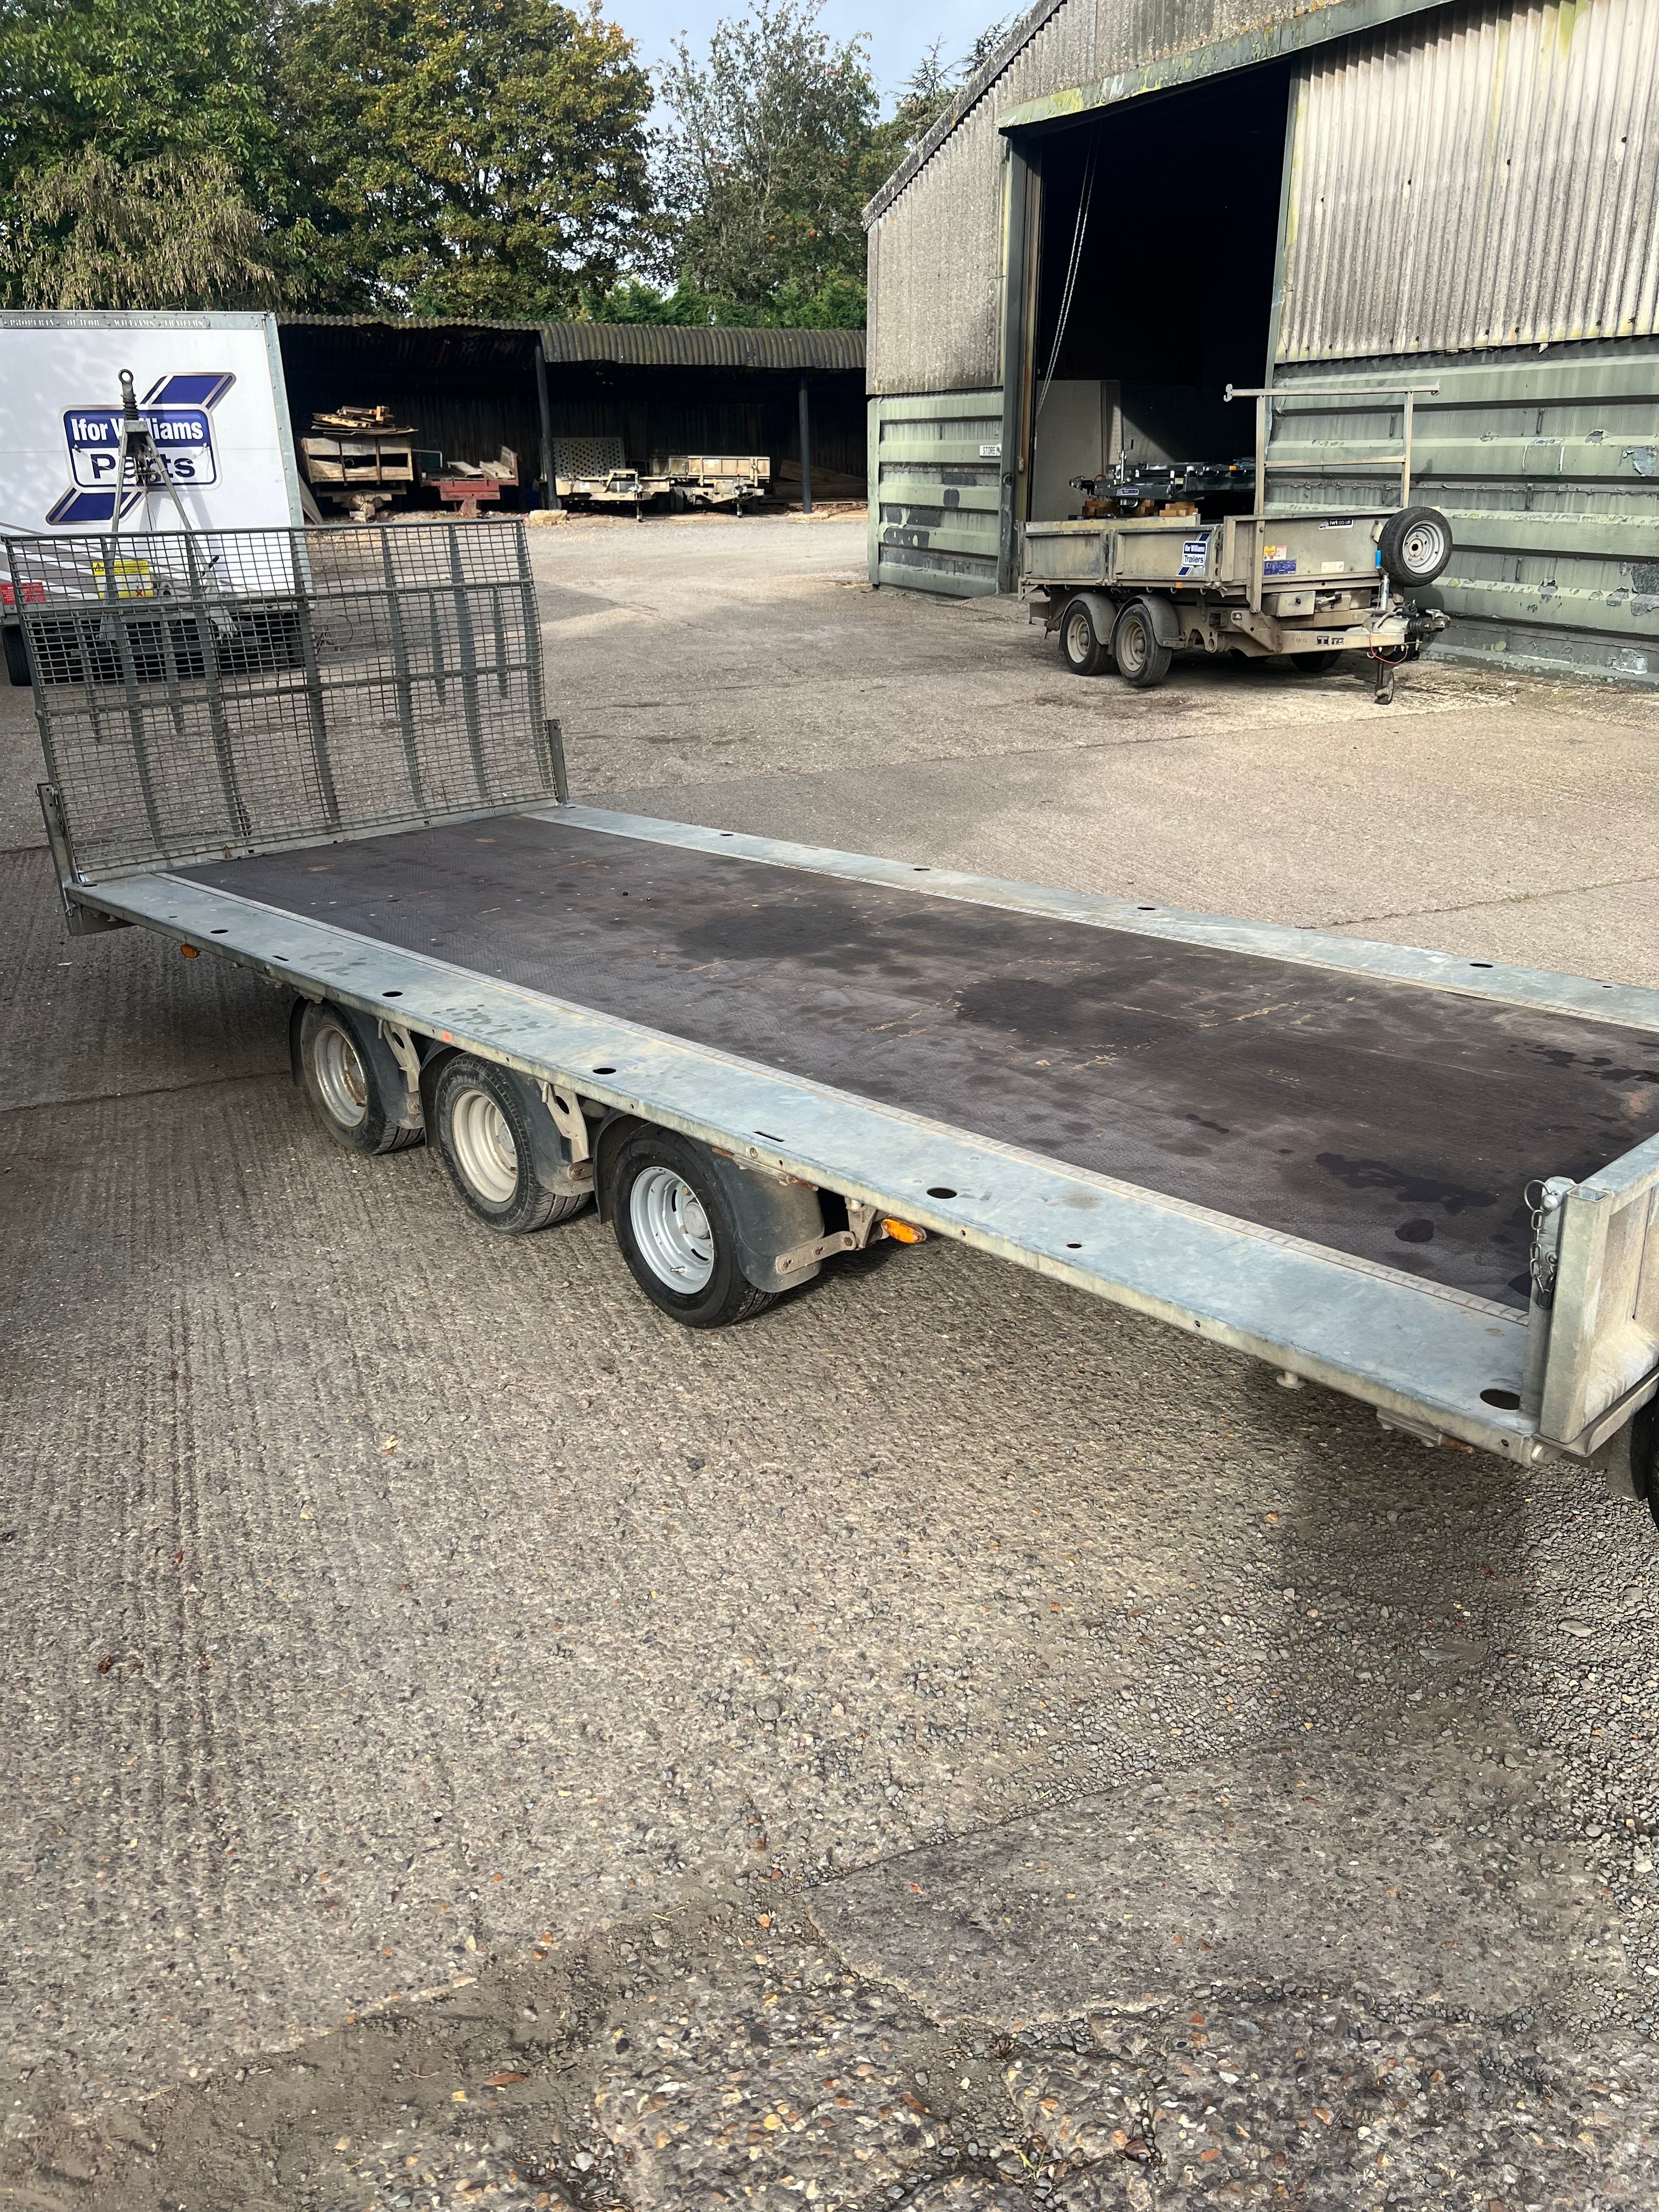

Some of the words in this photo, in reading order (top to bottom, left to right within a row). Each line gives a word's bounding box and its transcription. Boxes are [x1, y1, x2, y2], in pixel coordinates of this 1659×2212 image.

[71, 418, 108, 441] Ifor
[110, 417, 204, 439] Wliams
[1184, 555, 1204, 563] Trailers
